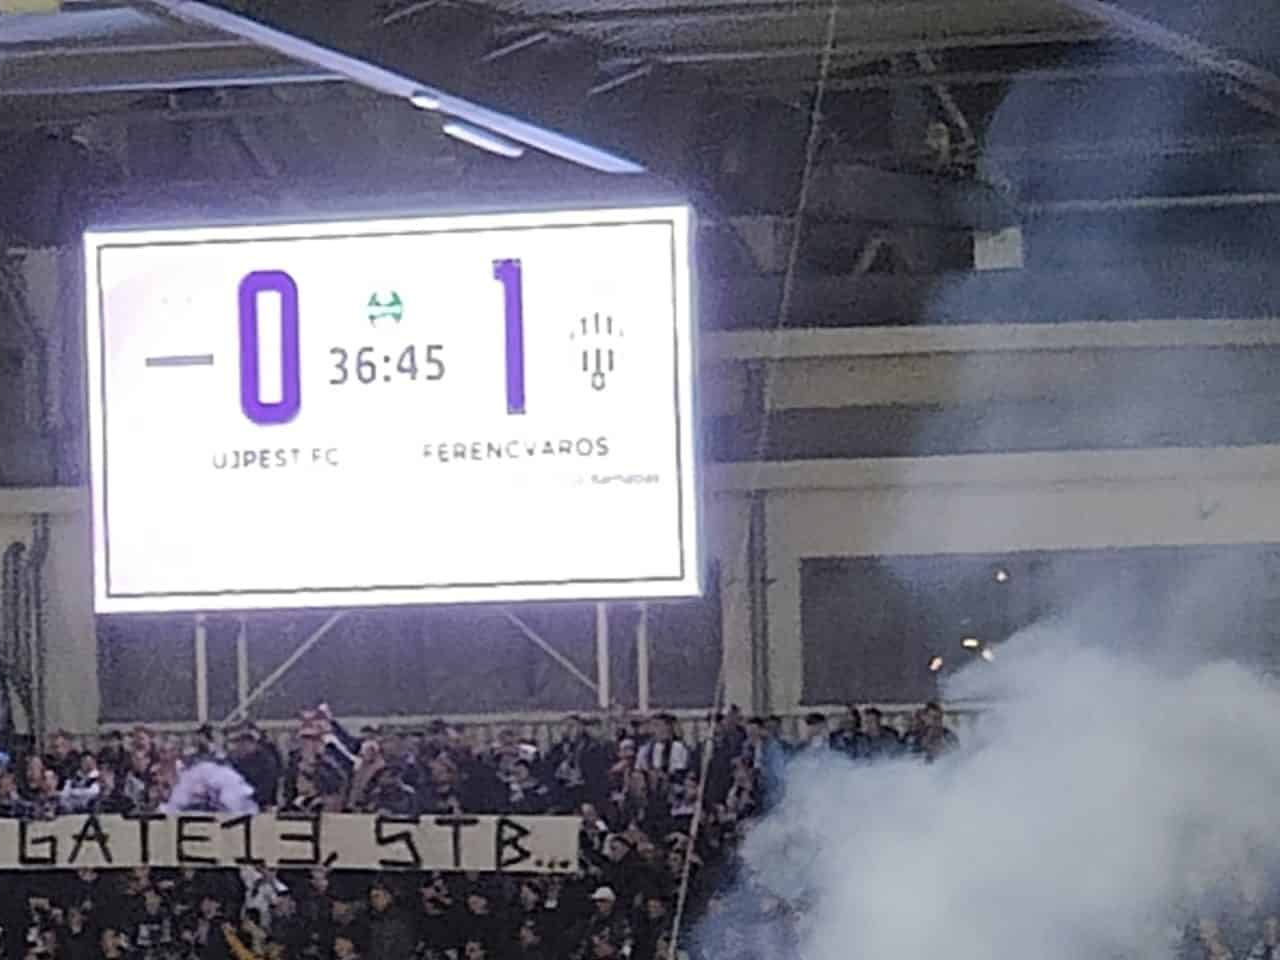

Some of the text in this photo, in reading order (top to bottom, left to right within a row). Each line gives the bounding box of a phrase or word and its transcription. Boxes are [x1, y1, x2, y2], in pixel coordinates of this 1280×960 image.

[237, 269, 302, 427] 0
[329, 344, 446, 386] 36:45
[492, 258, 527, 416] 1
[311, 447, 340, 467] FC
[18, 814, 340, 867] GATE13,
[375, 814, 571, 870] STB...
